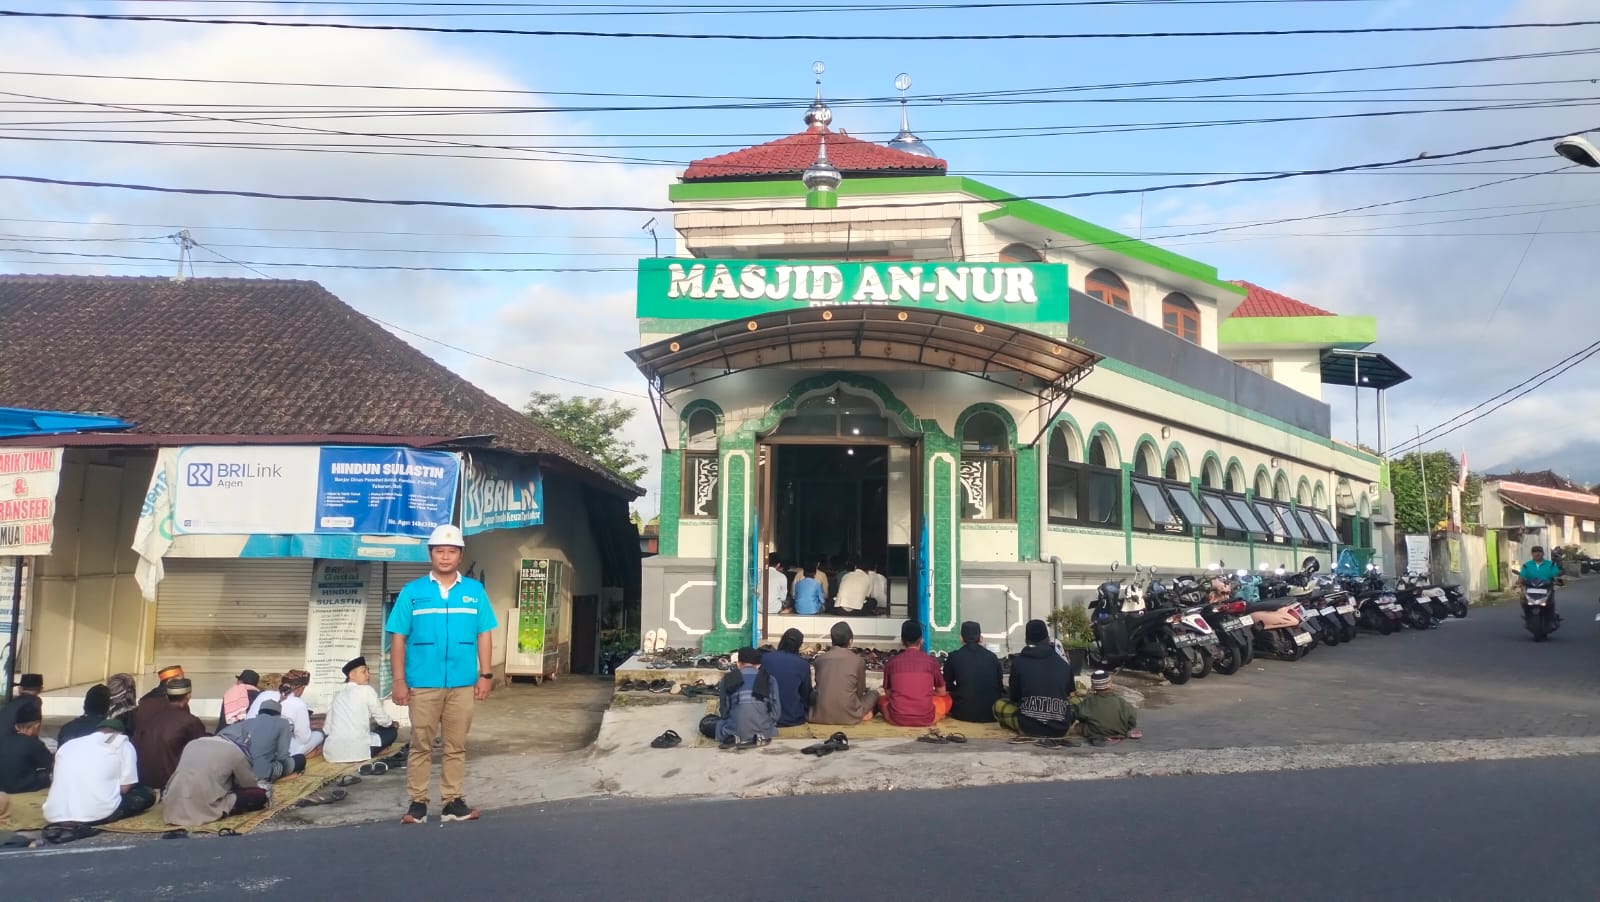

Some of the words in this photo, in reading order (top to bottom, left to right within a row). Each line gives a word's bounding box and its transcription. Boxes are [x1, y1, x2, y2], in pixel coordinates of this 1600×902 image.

[667, 263, 843, 301] MASJID
[852, 265, 1038, 303] AN-NUR
[23, 451, 53, 471] TUNAI
[217, 463, 283, 478] BRILink
[331, 463, 380, 475] HINDUN
[383, 464, 445, 479] SULASTIN
[15, 478, 26, 494] &
[217, 479, 243, 488] Agen
[24, 522, 50, 544] BANK
[322, 588, 358, 596] HINDUN
